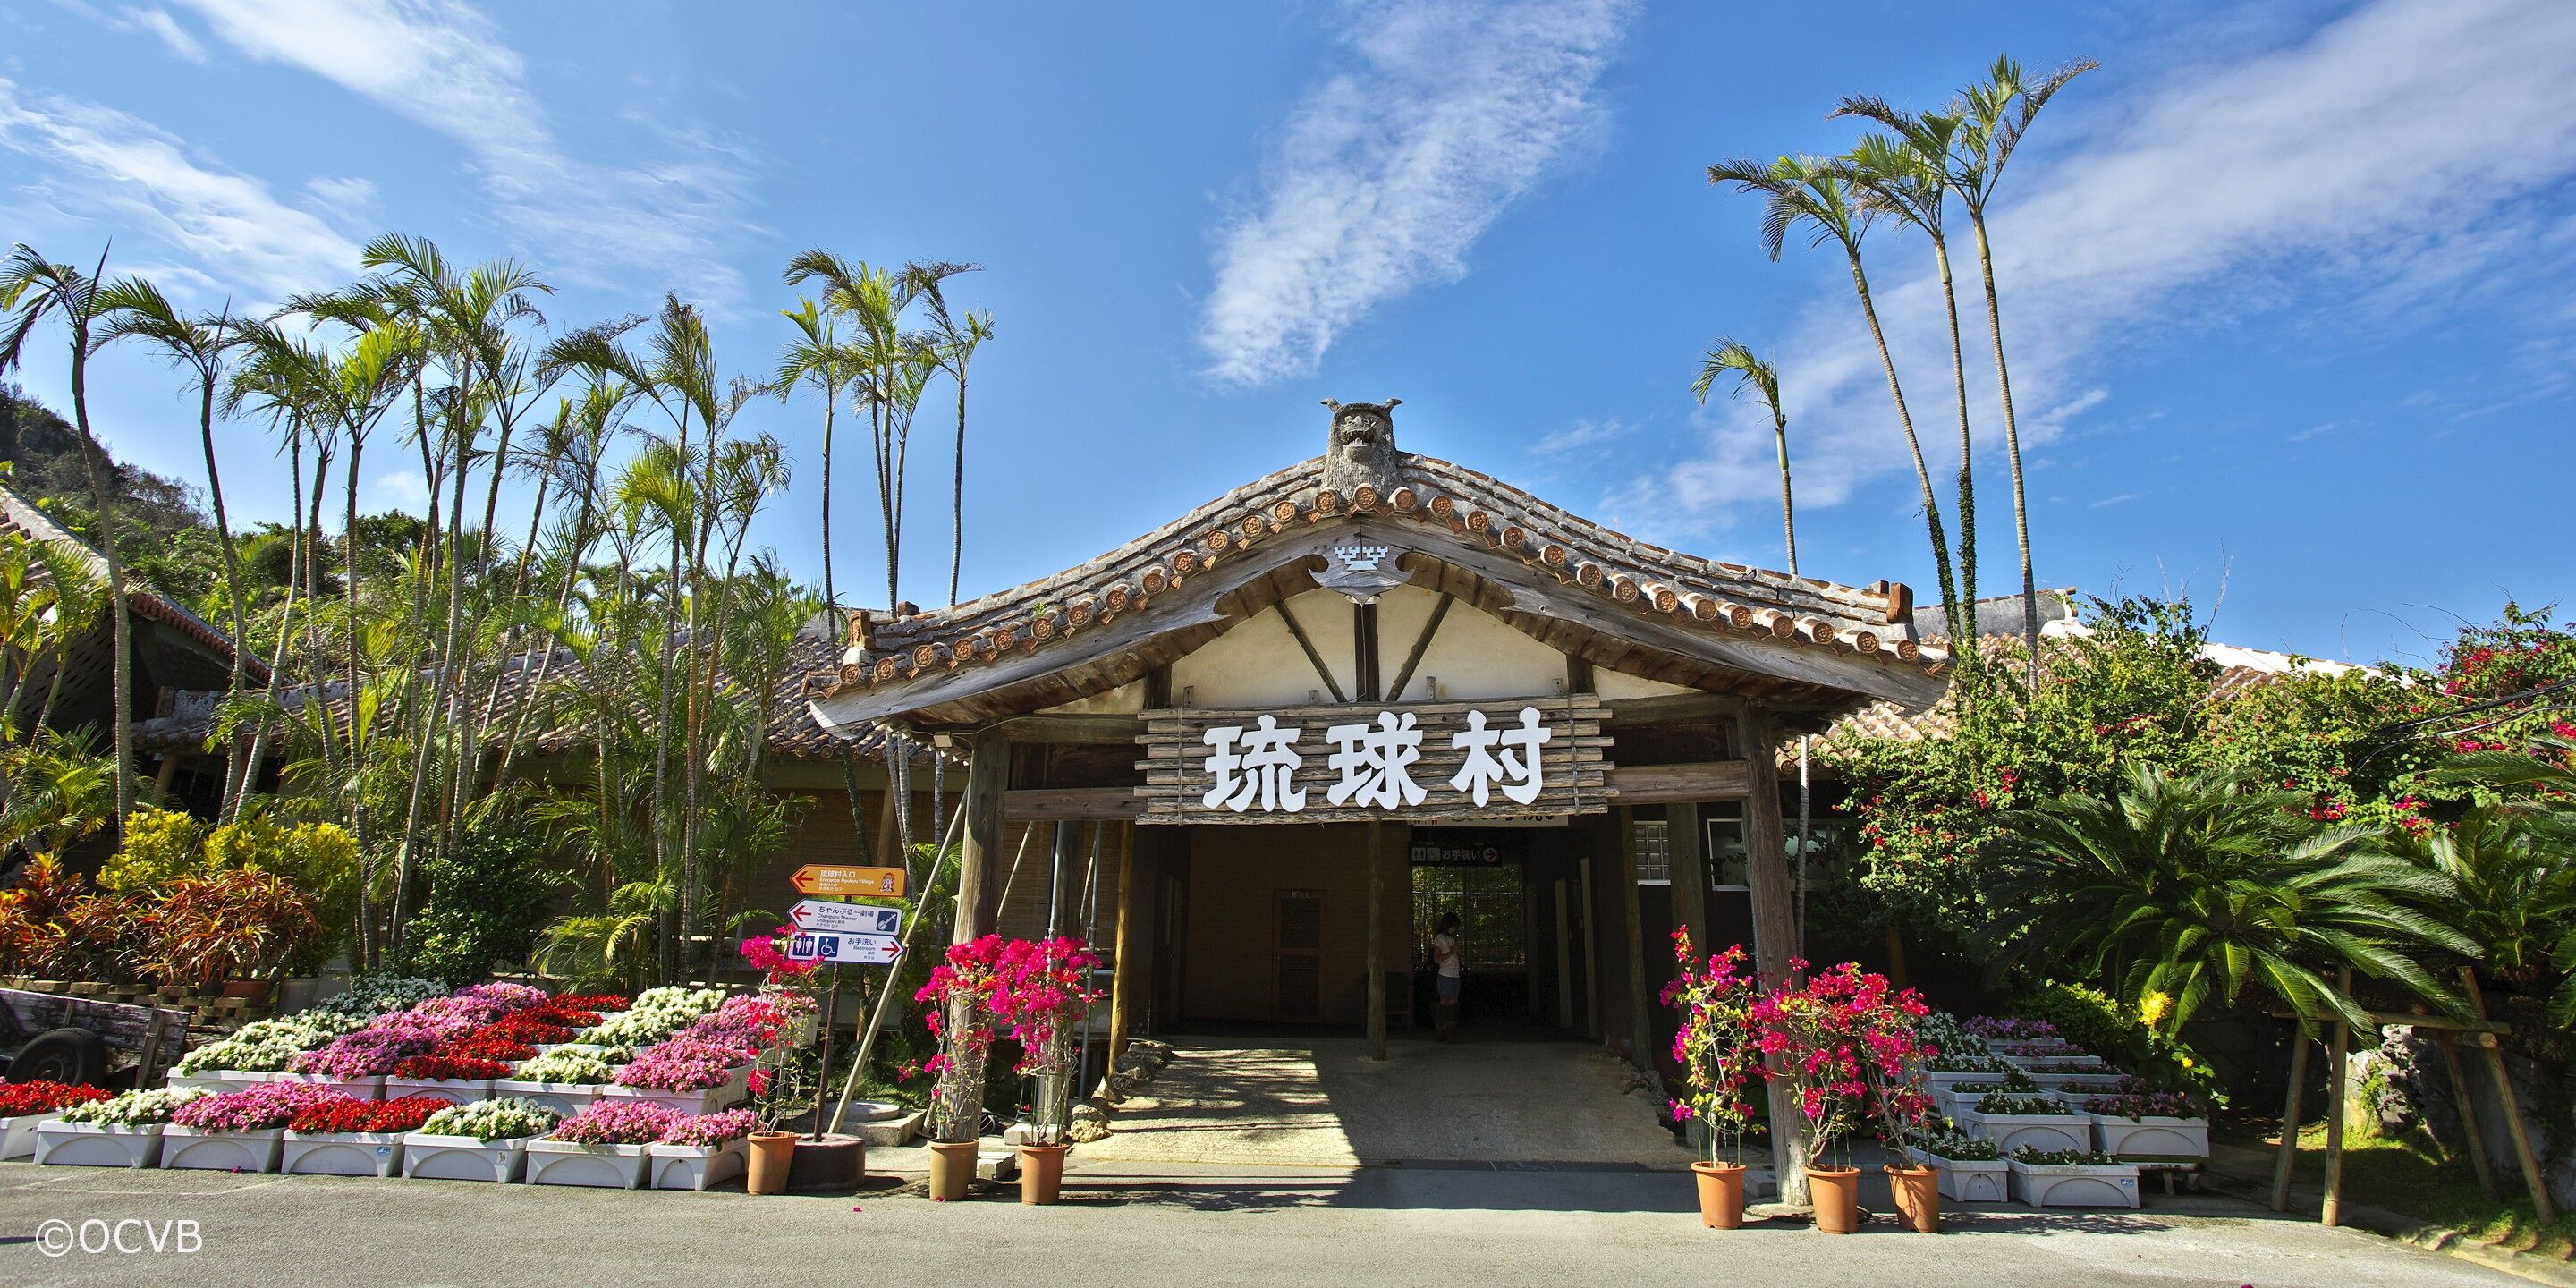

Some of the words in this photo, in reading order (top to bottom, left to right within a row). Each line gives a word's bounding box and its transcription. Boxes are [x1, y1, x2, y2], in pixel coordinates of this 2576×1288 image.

[1202, 706, 1551, 812] 琉球村
[1442, 849, 1480, 860] お手洗い
[819, 870, 856, 878] 琉球村入口
[818, 905, 875, 918] ちゃんぶるー劇場
[847, 937, 877, 945] お手洗い
